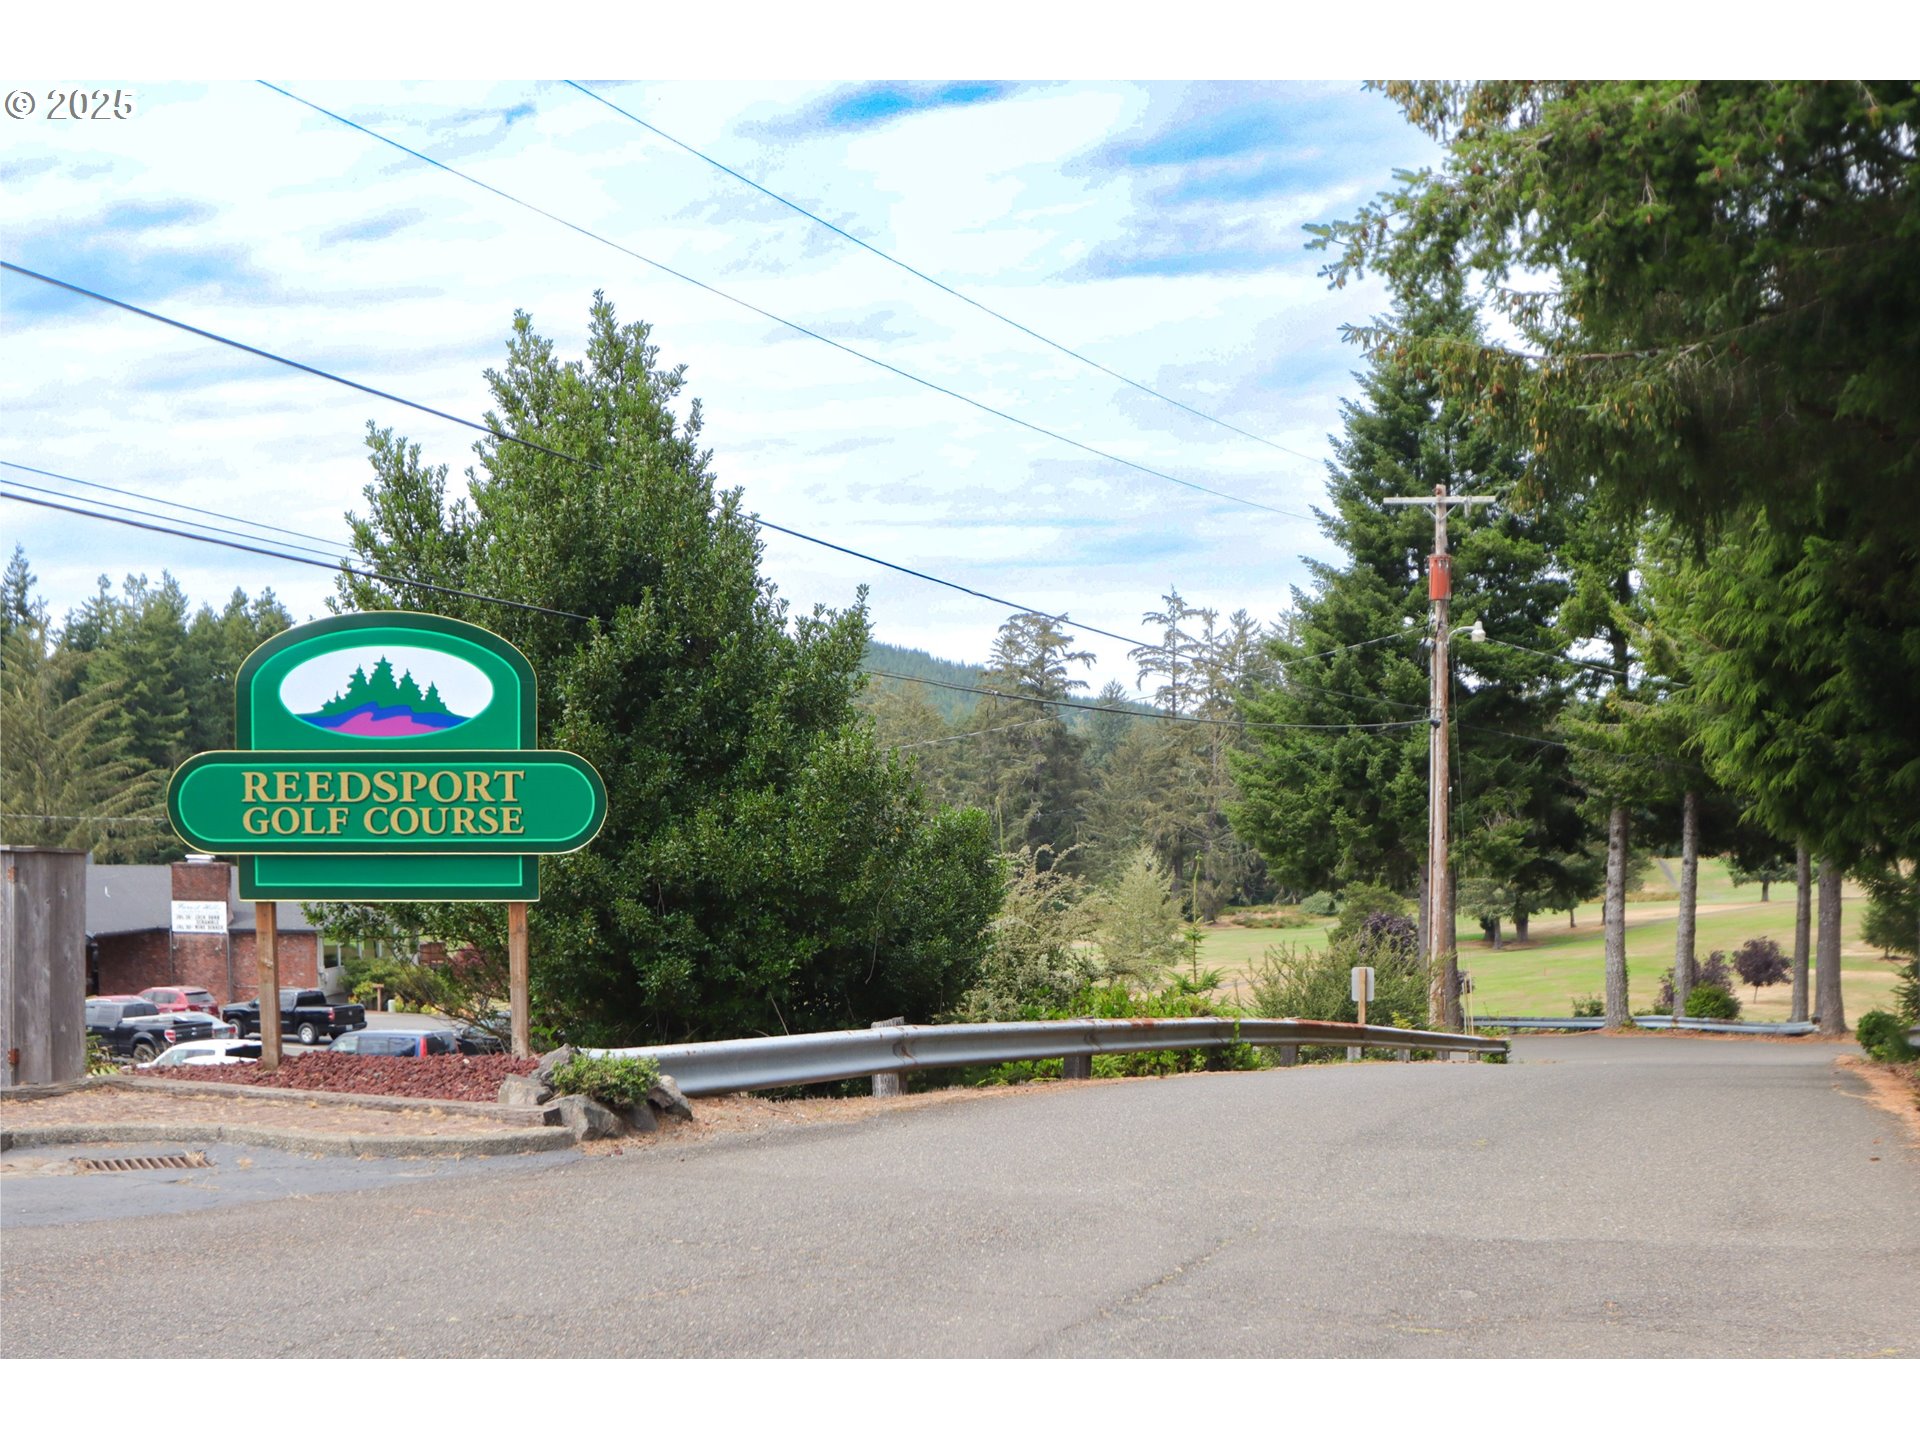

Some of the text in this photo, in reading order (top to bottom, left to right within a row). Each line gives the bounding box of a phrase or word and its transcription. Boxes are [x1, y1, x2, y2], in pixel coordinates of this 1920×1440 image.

[241, 770, 525, 803] REEDSPORT
[242, 806, 525, 835] GOLF COURSE
